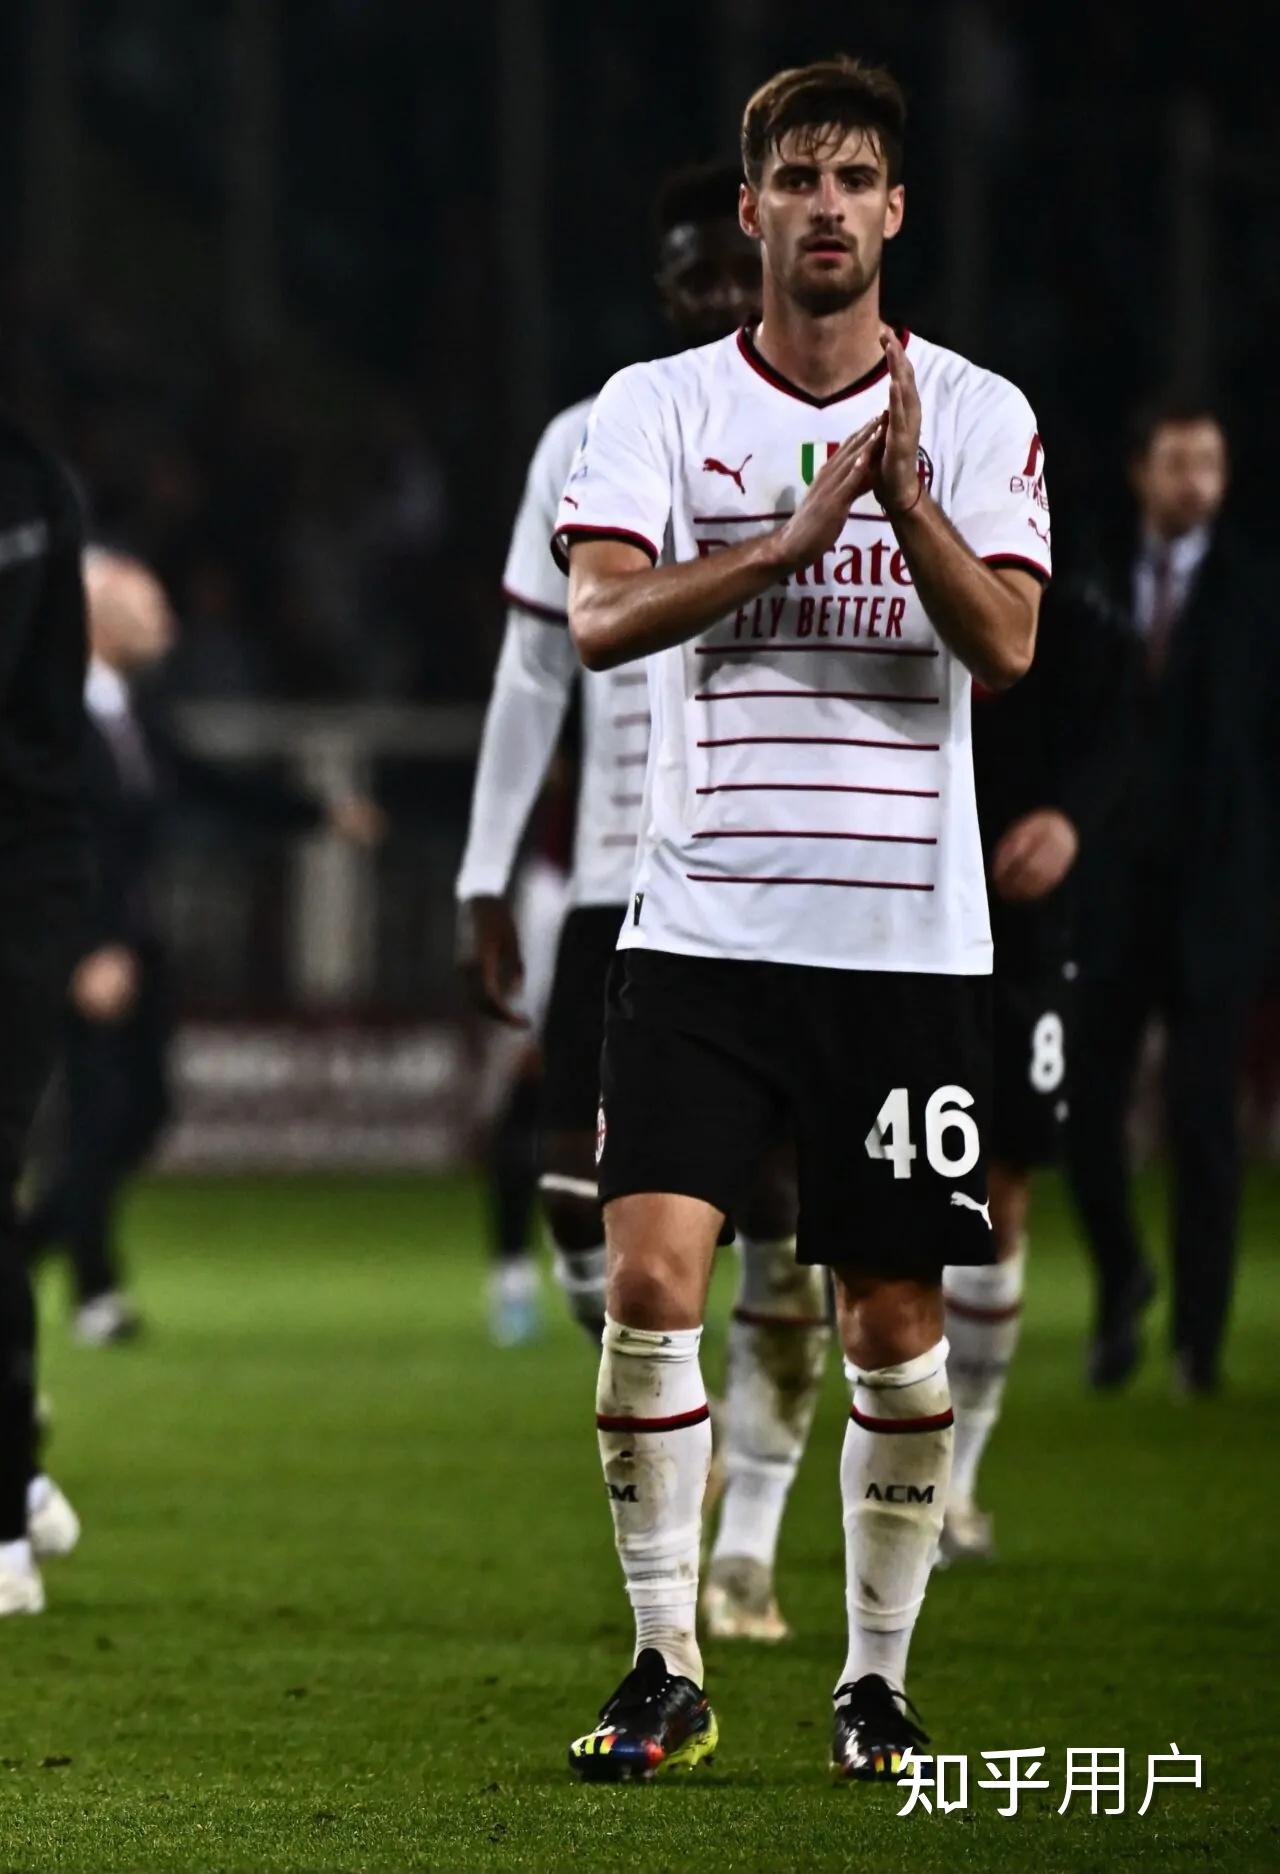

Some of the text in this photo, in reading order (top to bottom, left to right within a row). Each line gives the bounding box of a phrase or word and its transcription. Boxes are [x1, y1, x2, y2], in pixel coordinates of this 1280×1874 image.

[734, 596, 906, 639] FLY BETTER
[1030, 1011, 1065, 1093] 8
[865, 1084, 980, 1179] 46
[865, 1482, 935, 1504] ACM
